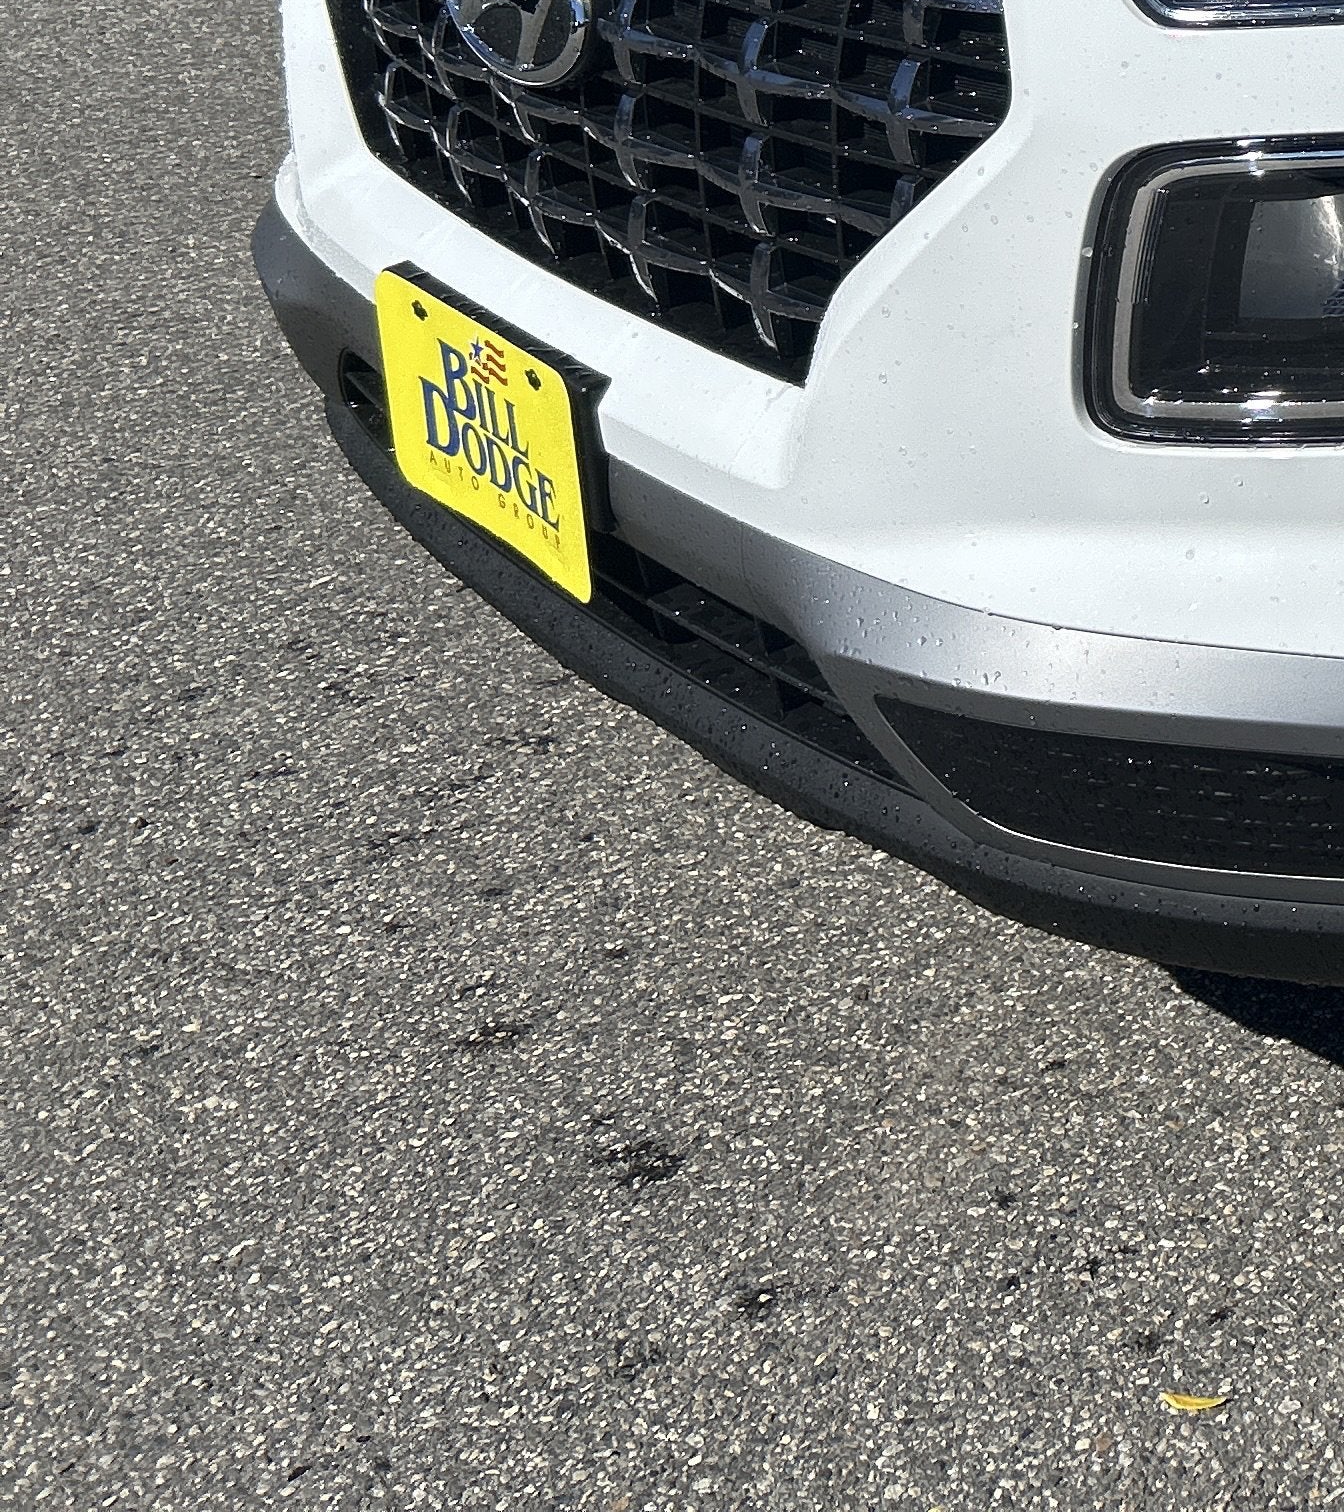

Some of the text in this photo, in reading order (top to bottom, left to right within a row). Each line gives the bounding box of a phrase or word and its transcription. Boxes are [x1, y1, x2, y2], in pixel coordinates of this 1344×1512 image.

[419, 377, 560, 531] DODGE
[436, 337, 530, 459] BILL
[429, 449, 561, 550] AUTO GROUP
